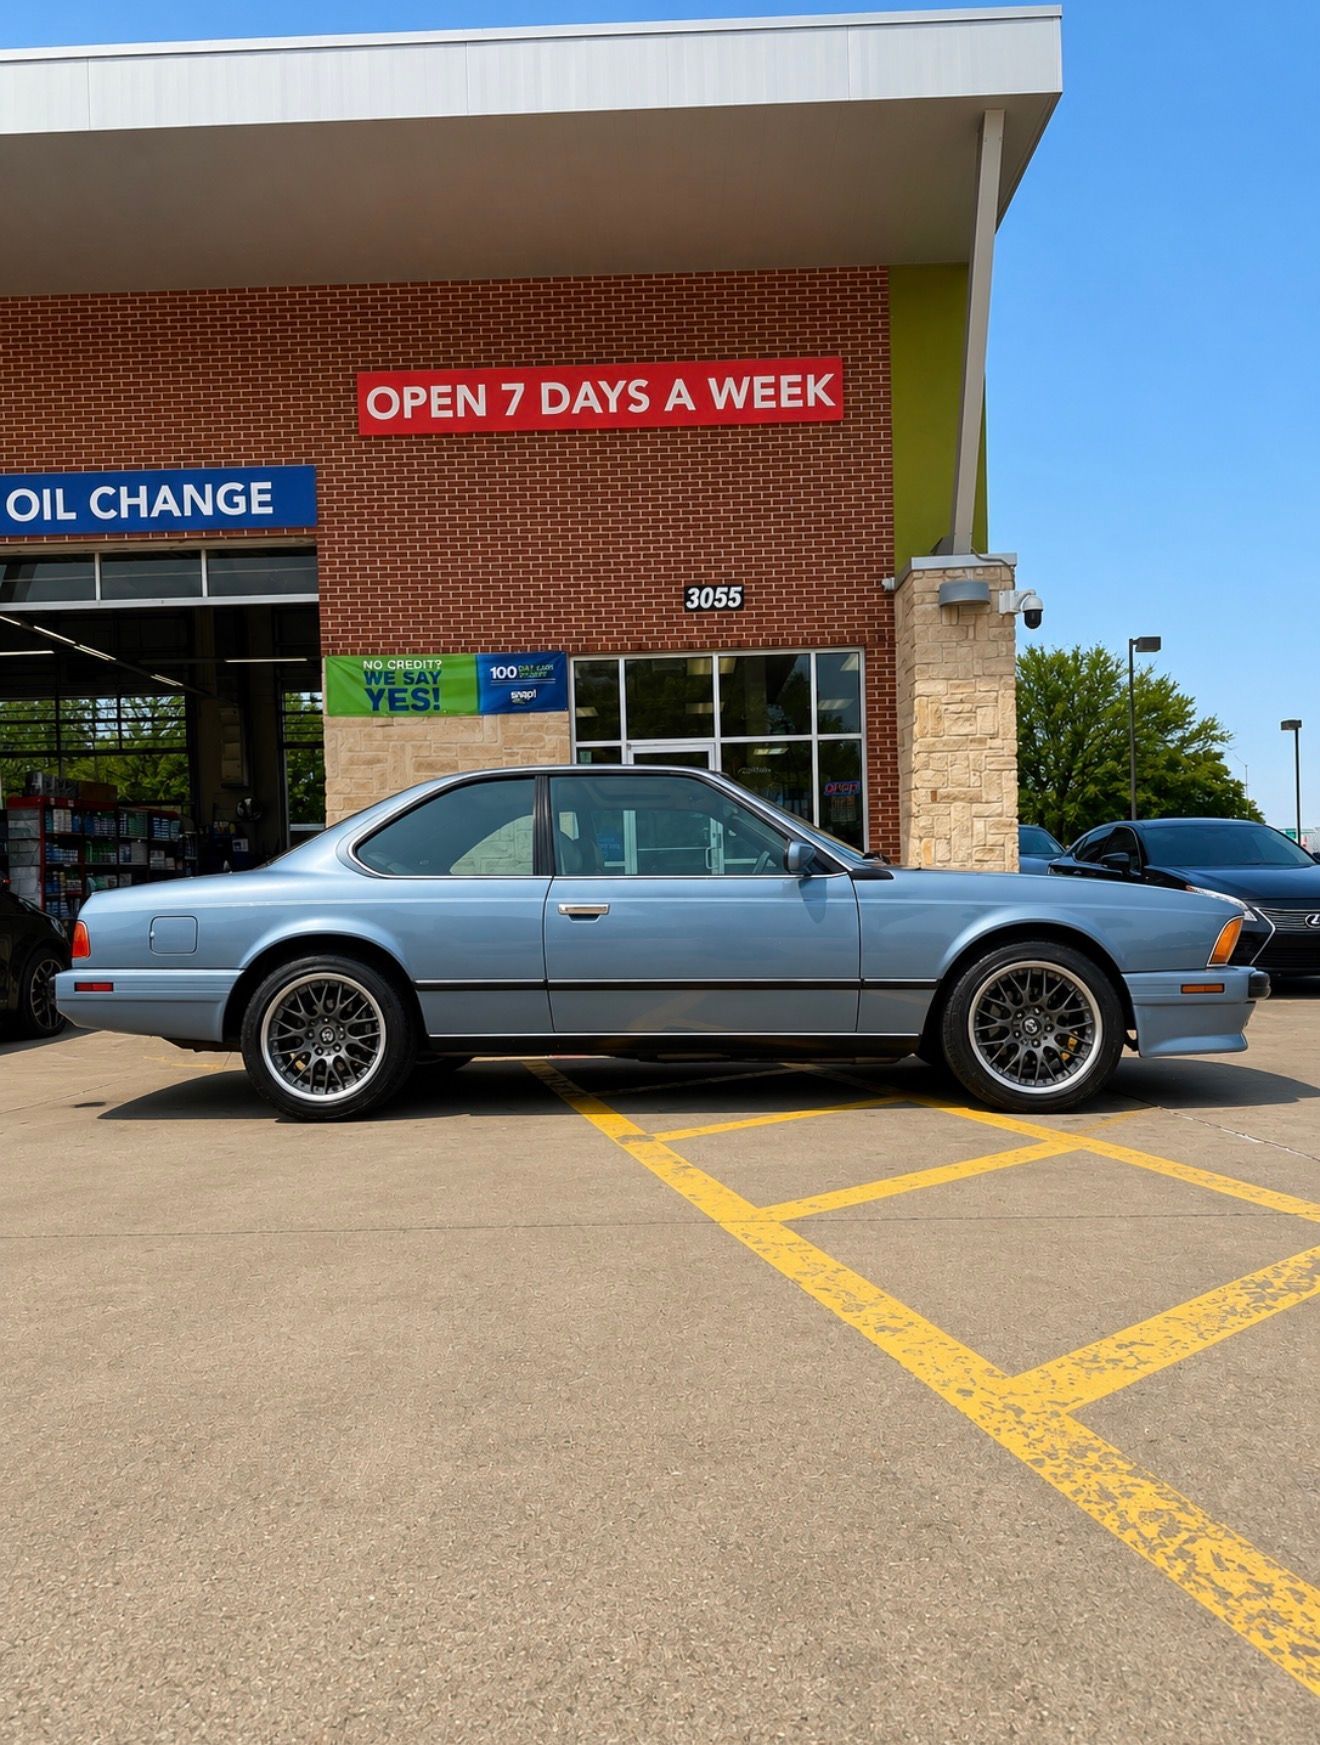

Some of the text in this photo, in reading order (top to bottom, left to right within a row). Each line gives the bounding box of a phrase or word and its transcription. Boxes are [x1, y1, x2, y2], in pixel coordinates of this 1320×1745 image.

[366, 373, 836, 420] OPEN 7 DAYS A WEEK
[6, 481, 274, 522] OIL CHANGE
[686, 586, 741, 609] 3055
[363, 659, 442, 670] NO CREDIT?
[490, 665, 518, 679] 100
[363, 670, 442, 685] WE SAY
[364, 687, 441, 712] YES!
